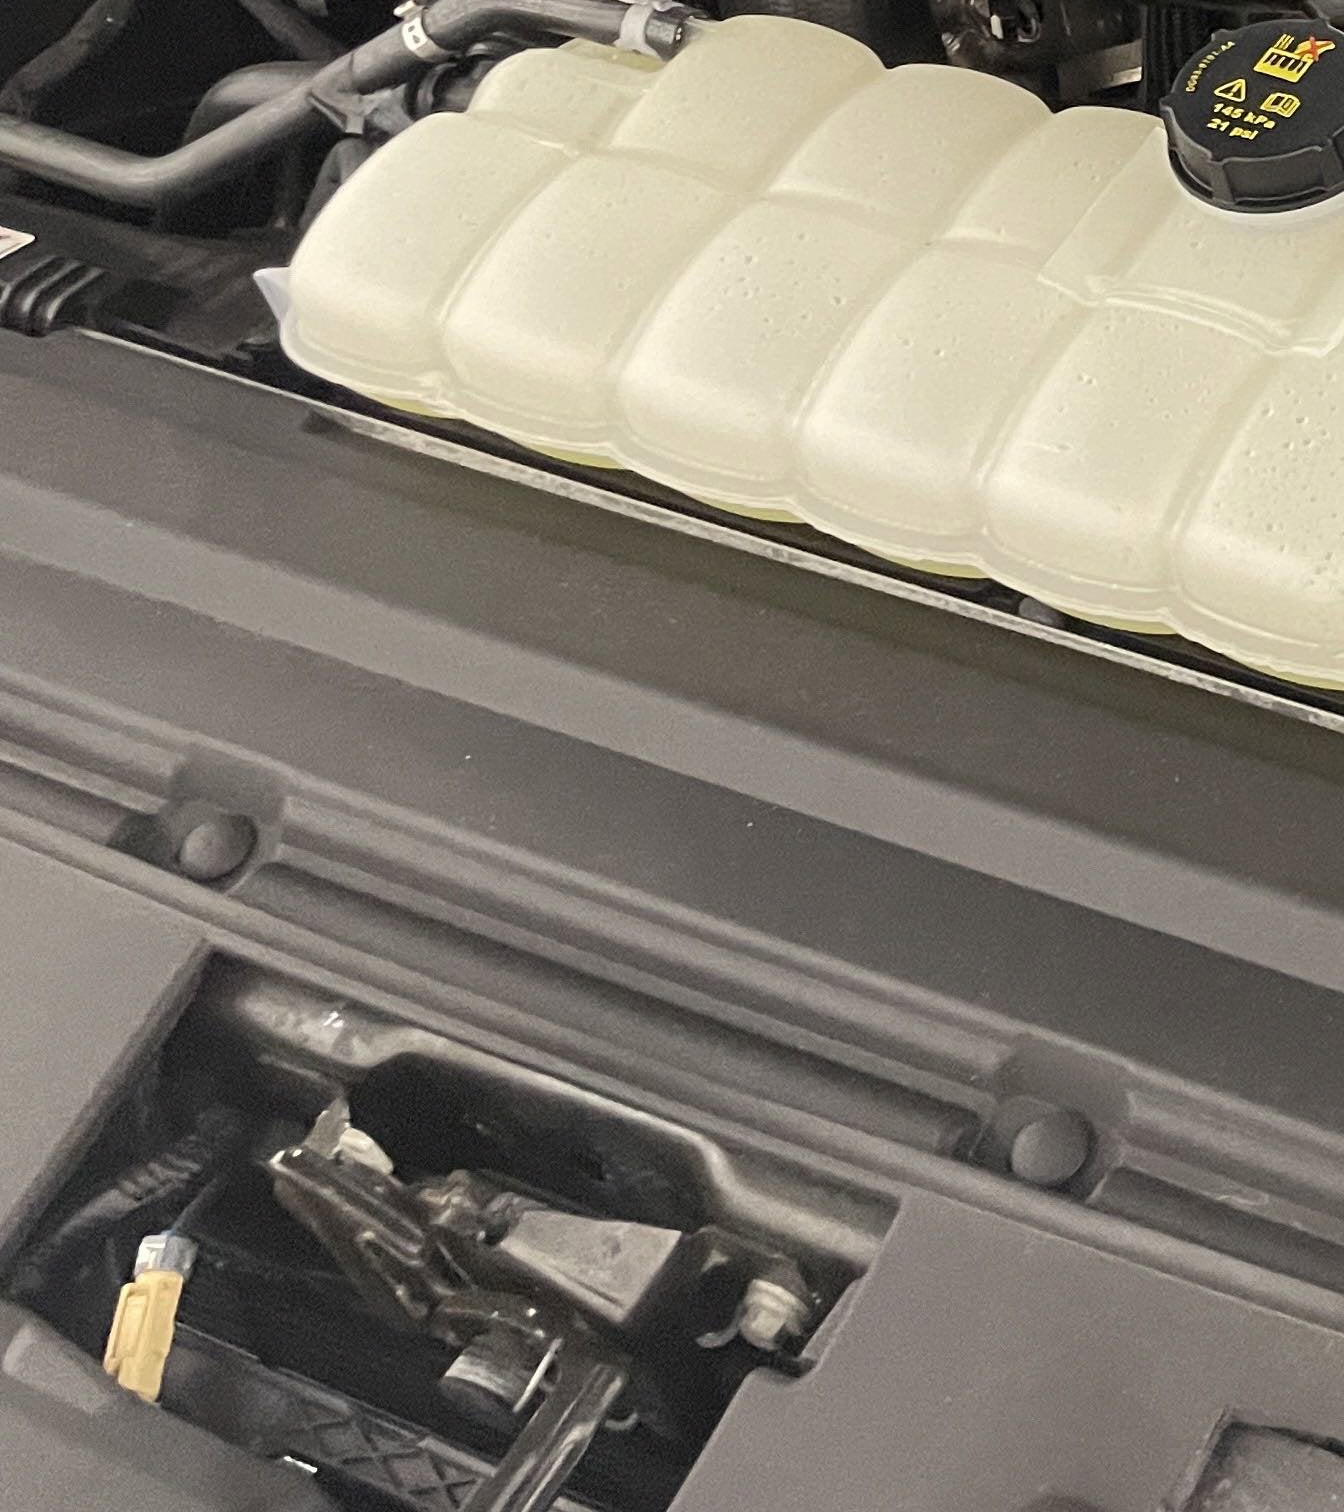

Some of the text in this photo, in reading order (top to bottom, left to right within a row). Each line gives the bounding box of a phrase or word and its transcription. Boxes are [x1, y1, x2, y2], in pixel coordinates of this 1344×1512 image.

[1213, 104, 1276, 129] 145 kPa
[1206, 119, 1259, 140] 21 psi
